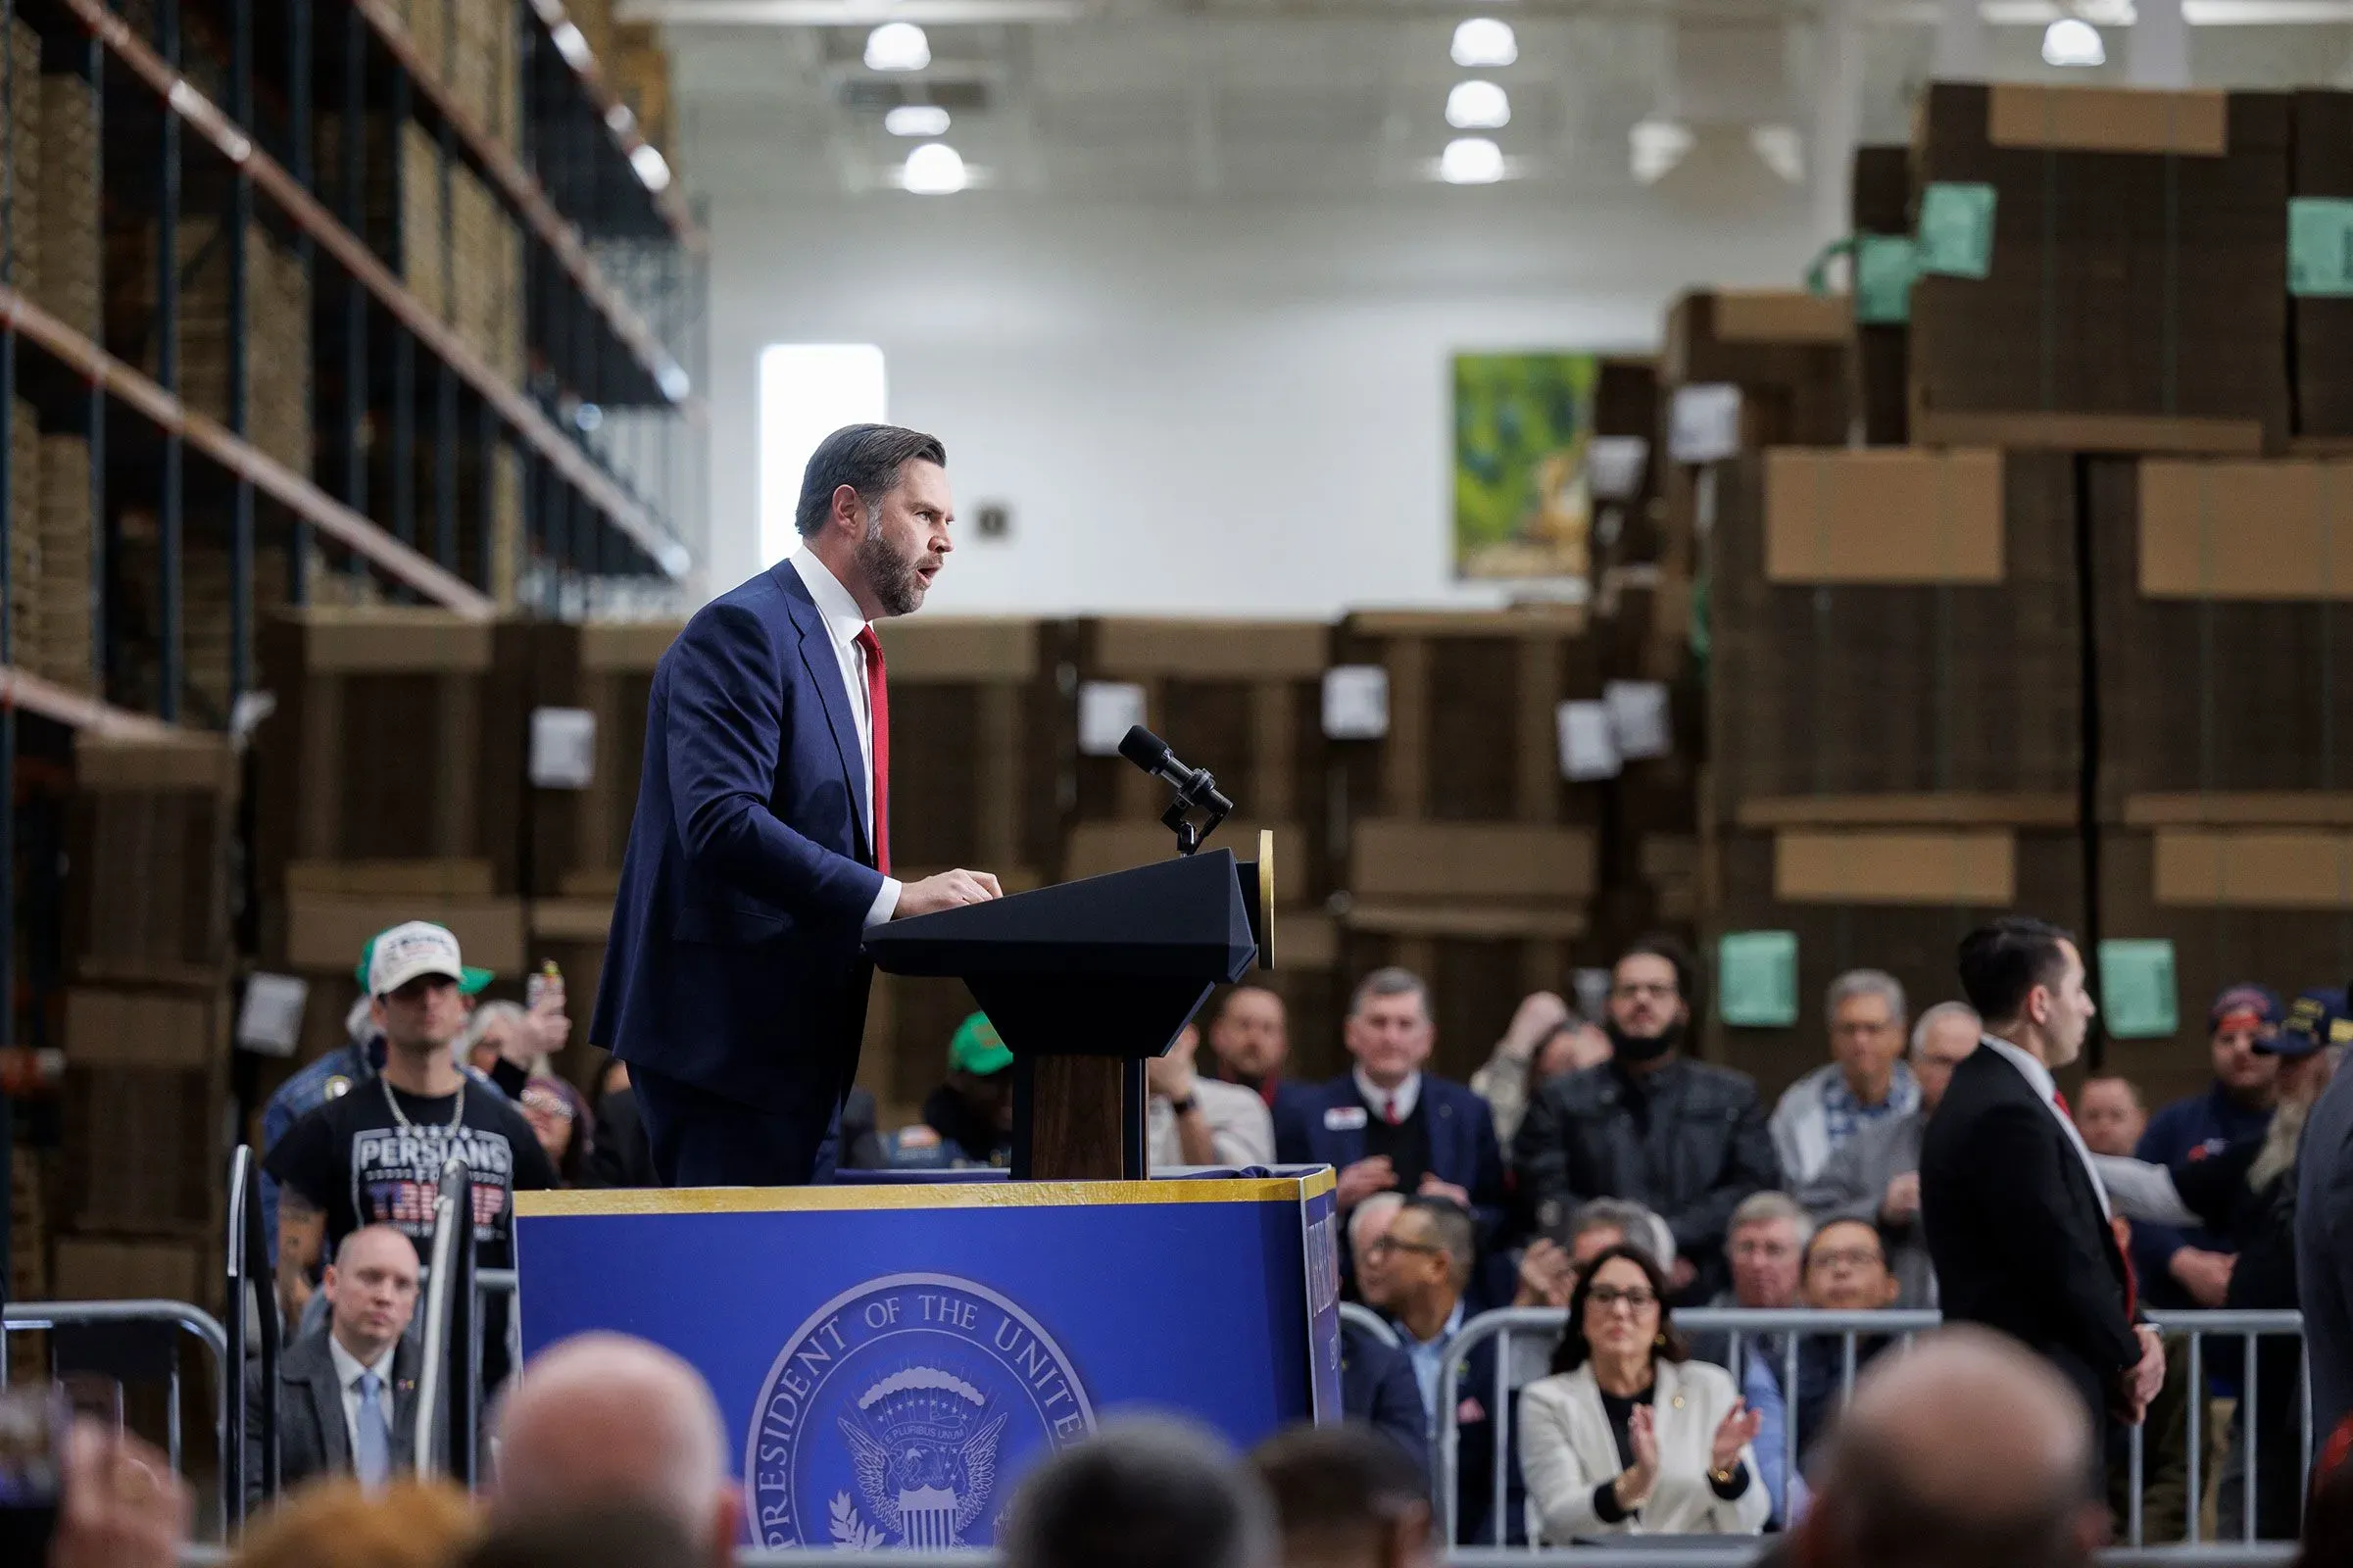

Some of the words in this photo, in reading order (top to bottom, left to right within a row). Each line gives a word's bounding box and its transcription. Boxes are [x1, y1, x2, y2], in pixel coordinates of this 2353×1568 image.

[360, 1137, 509, 1173] PERSIANS
[759, 1316, 847, 1552] PRESIDENT
[864, 1297, 901, 1328] OF
[918, 1295, 978, 1331] THE
[994, 1315, 1083, 1452] UNITE
[885, 1434, 893, 1445] E
[892, 1425, 936, 1439] PLURIBUS
[938, 1428, 964, 1441] UNUM
